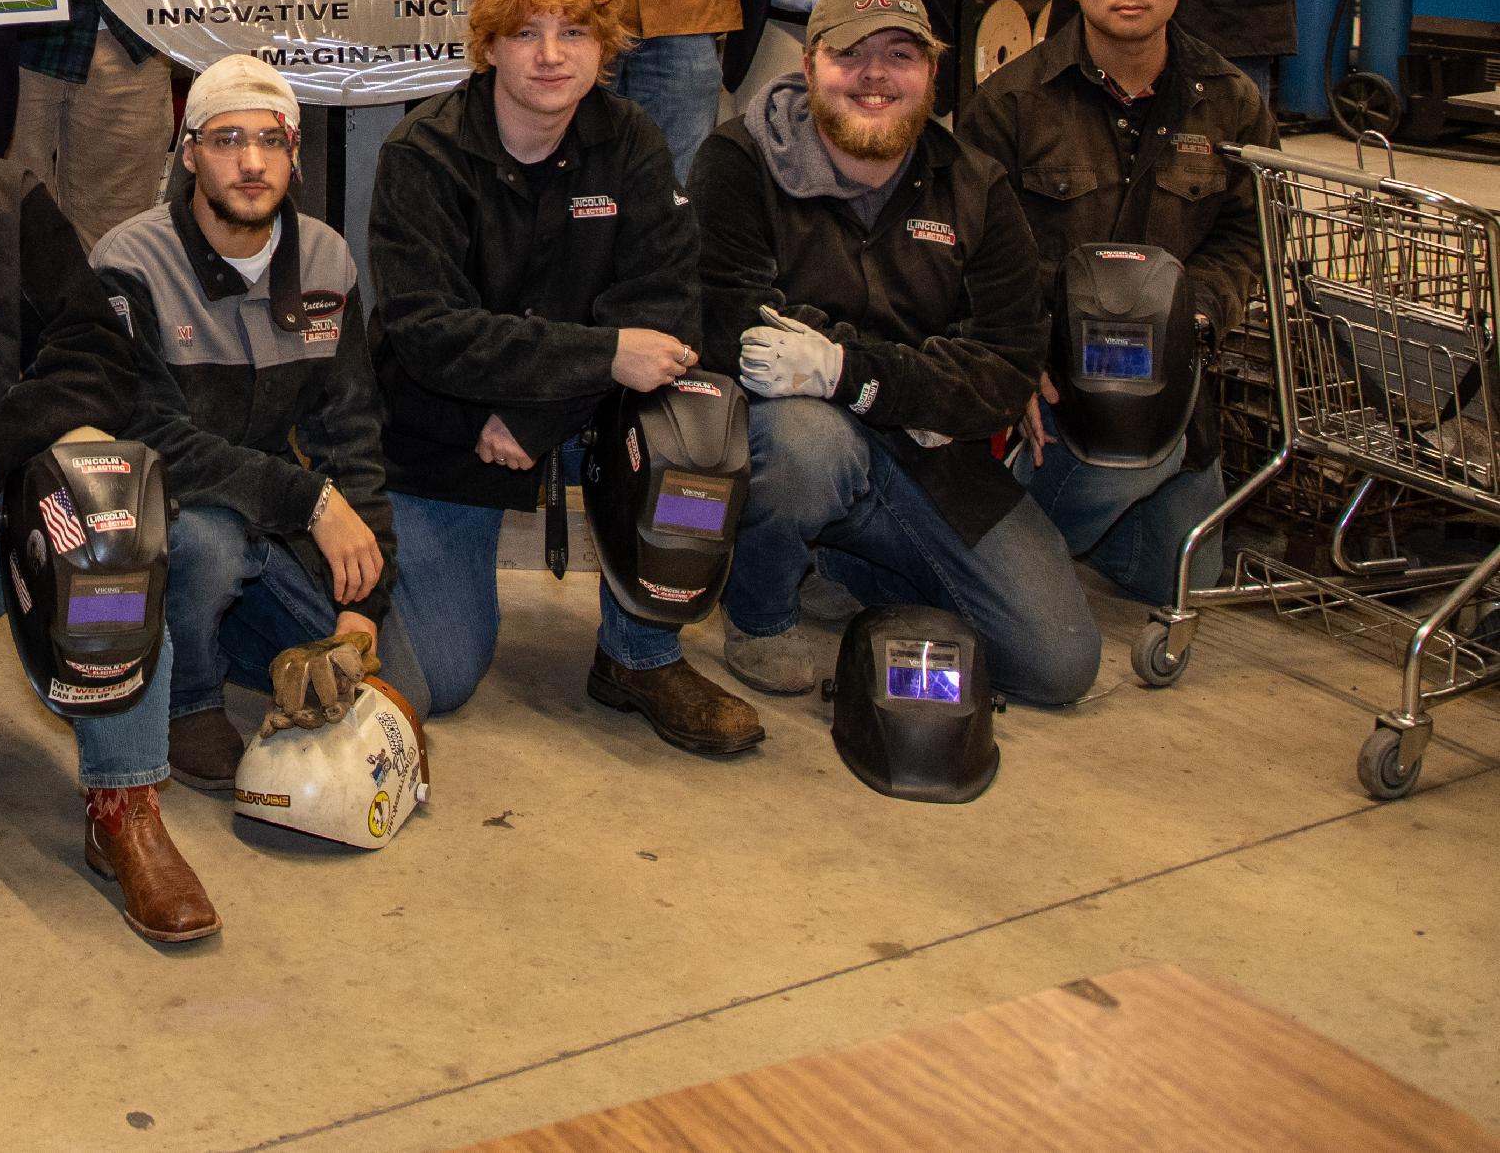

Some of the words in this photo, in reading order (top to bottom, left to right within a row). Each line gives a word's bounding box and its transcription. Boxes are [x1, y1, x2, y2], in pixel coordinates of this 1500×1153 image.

[146, 2, 349, 25] INNOVATIVE
[250, 42, 465, 66] IMAGINATIVE
[573, 197, 606, 207] INCOLN
[578, 207, 612, 215] ELECTRIC
[910, 220, 948, 234] LINCOLN
[918, 230, 951, 243] ELECTRIC
[75, 457, 119, 466] LINCOLN
[89, 512, 126, 524] LINCOLN
[52, 679, 73, 692] MY
[74, 683, 126, 694] WELDER
[51, 690, 69, 700] CAN
[235, 788, 291, 807] LDTUBE
